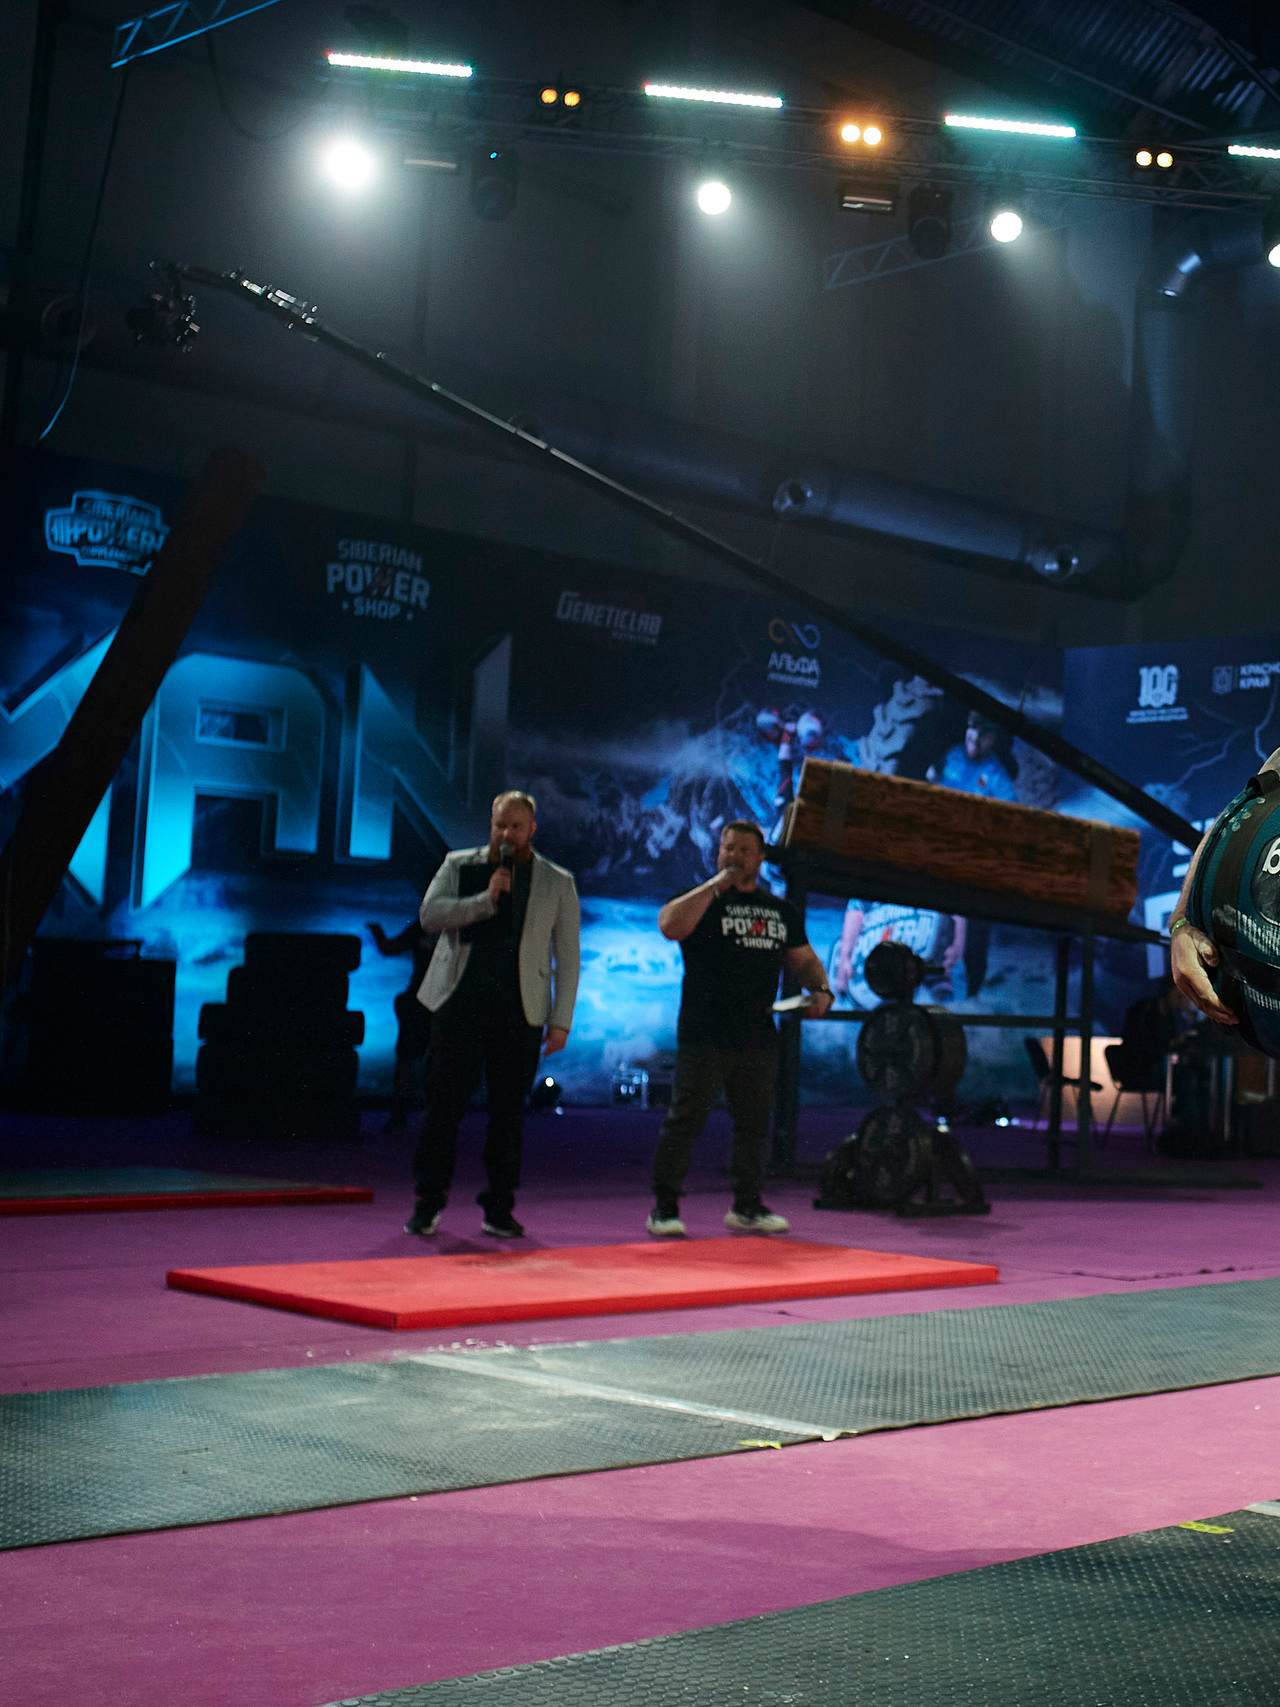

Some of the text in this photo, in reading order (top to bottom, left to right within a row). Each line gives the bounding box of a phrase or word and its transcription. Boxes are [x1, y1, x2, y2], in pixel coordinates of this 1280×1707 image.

[337, 539, 424, 574] SIBERIAN
[725, 903, 781, 922] SIBERIAN
[721, 916, 788, 943] POWER
[742, 937, 774, 950] SHOW
